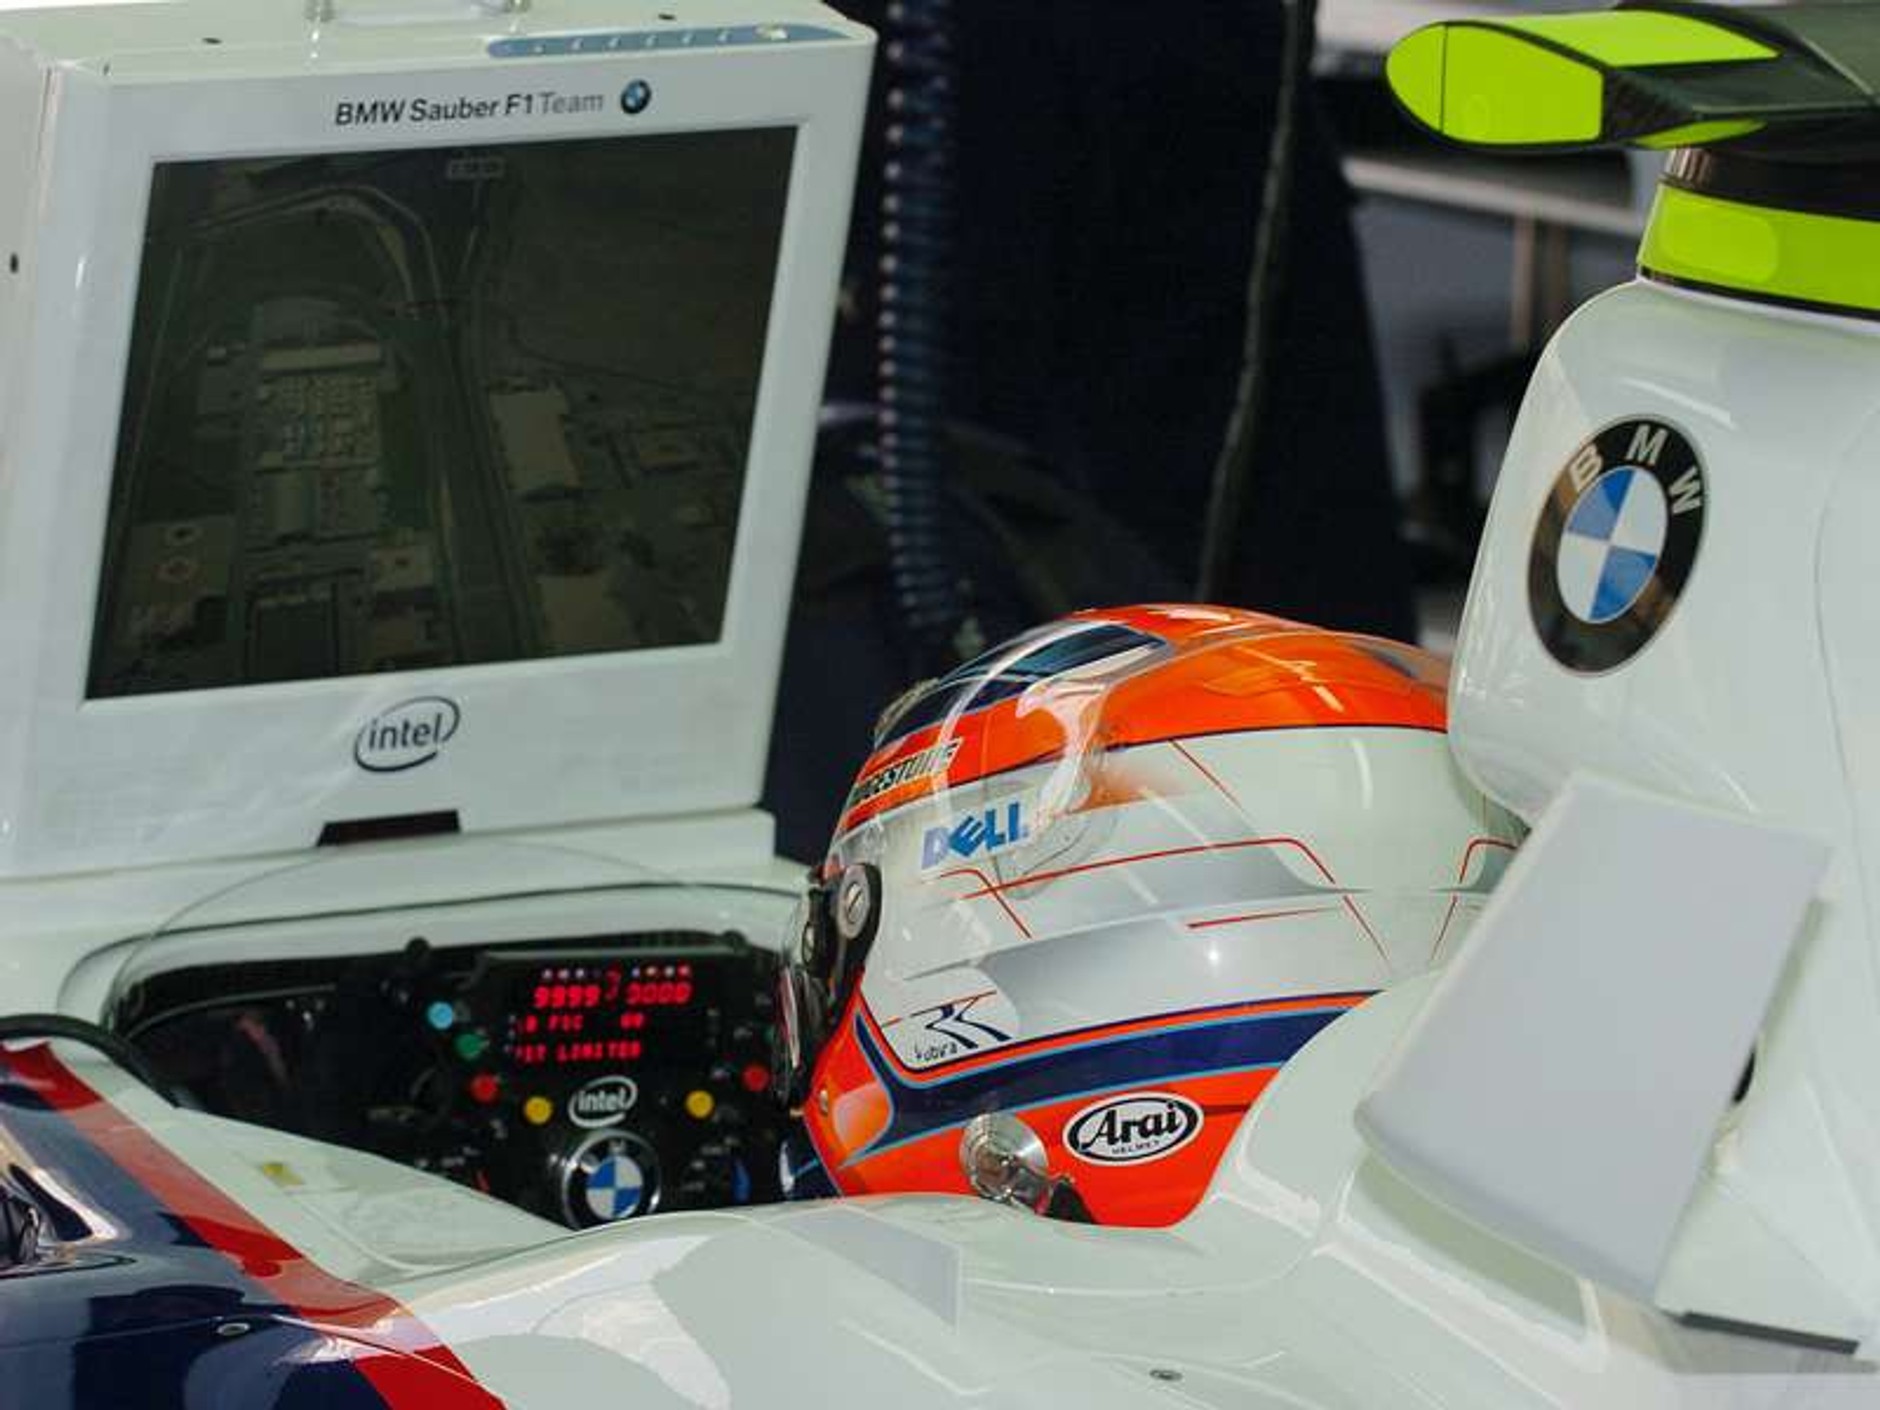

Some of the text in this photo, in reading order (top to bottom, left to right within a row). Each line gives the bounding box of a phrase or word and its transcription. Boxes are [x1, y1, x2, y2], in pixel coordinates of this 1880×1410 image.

[334, 91, 604, 126] BMW Sauber F1 Team
[1568, 424, 1703, 516] BMW
[368, 712, 443, 750] intel
[921, 801, 1029, 870] DELL
[1079, 1102, 1183, 1150] Arai
